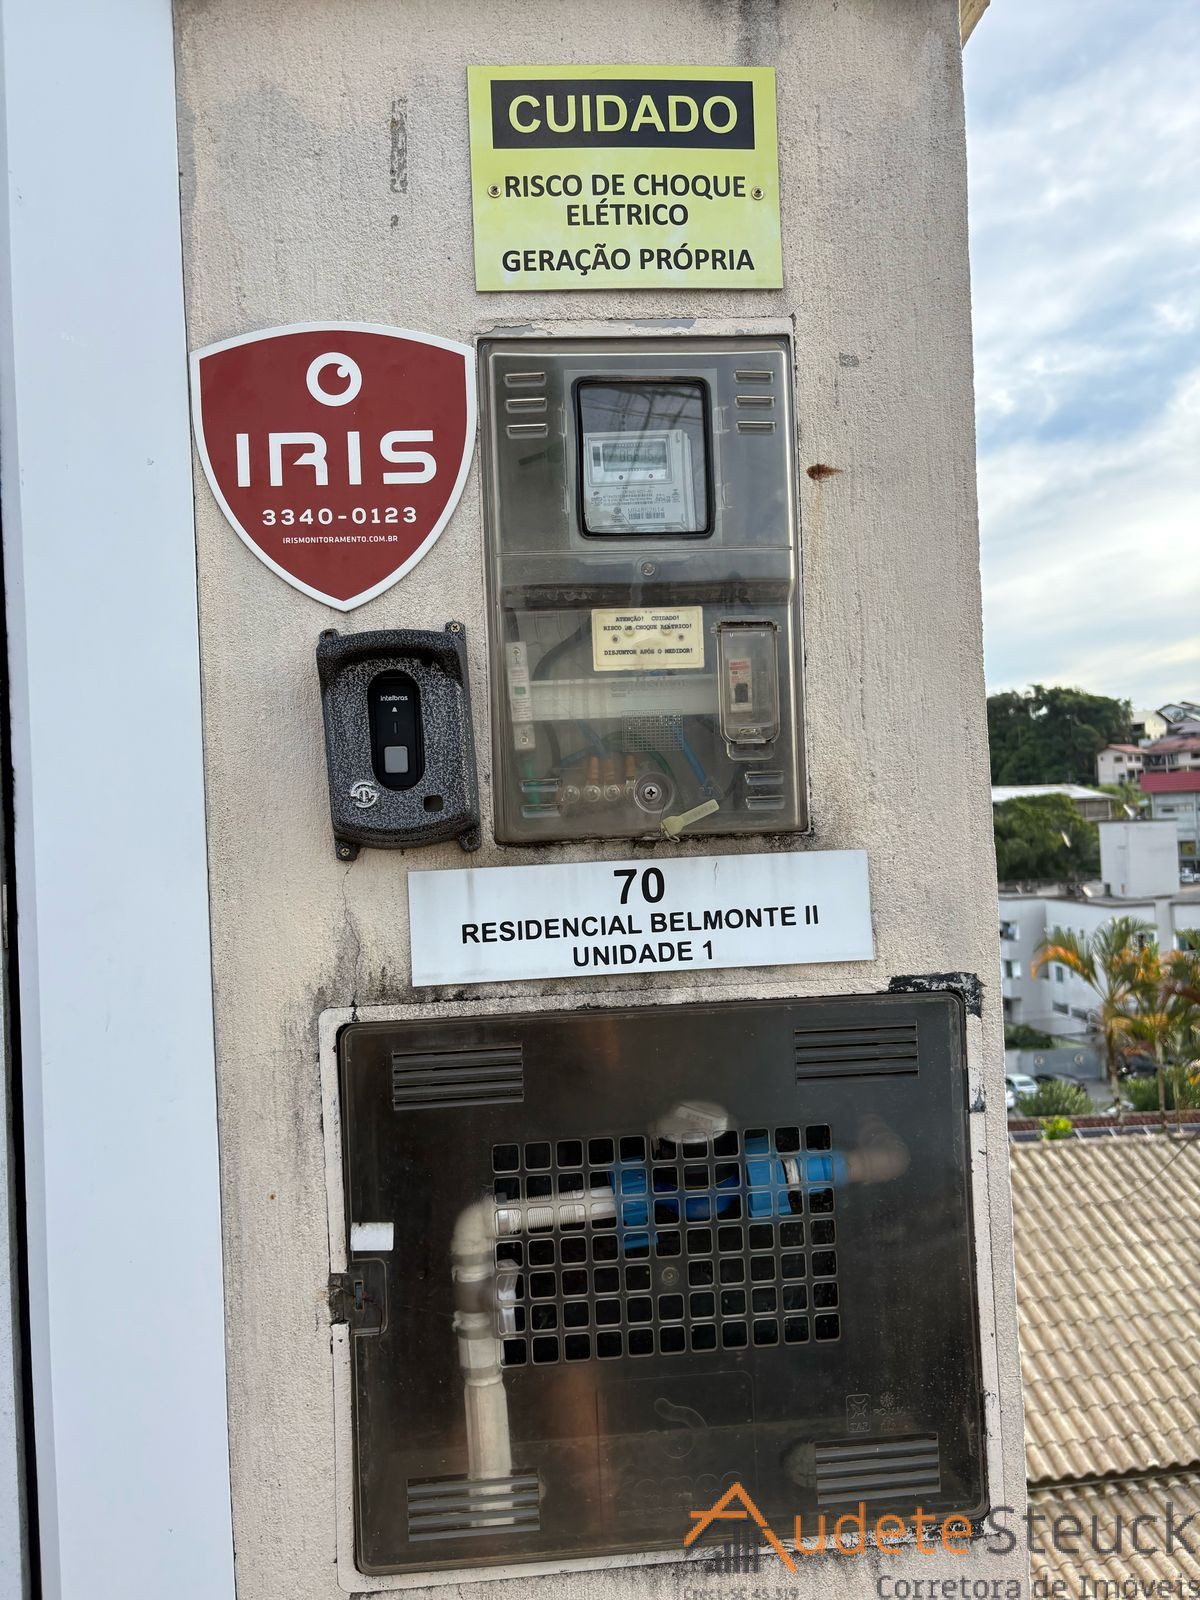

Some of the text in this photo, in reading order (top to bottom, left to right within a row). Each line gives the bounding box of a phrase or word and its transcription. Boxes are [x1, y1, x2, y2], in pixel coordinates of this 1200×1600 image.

[508, 94, 738, 134] CUIDADO
[504, 174, 746, 200] RISCO DE CHOQUE
[566, 198, 689, 226] ELÉTRICO
[502, 243, 755, 276] GERAÇÃO PRÓPRIA
[236, 430, 437, 487] IRIS
[262, 507, 417, 525] 3340-0123
[282, 535, 398, 544] IRISMONITORAMENTO.COM.BR
[613, 867, 666, 905] 70
[461, 905, 819, 944] RESIDENCIAL BELMONTE II
[573, 940, 714, 967] UNIDADE 1
